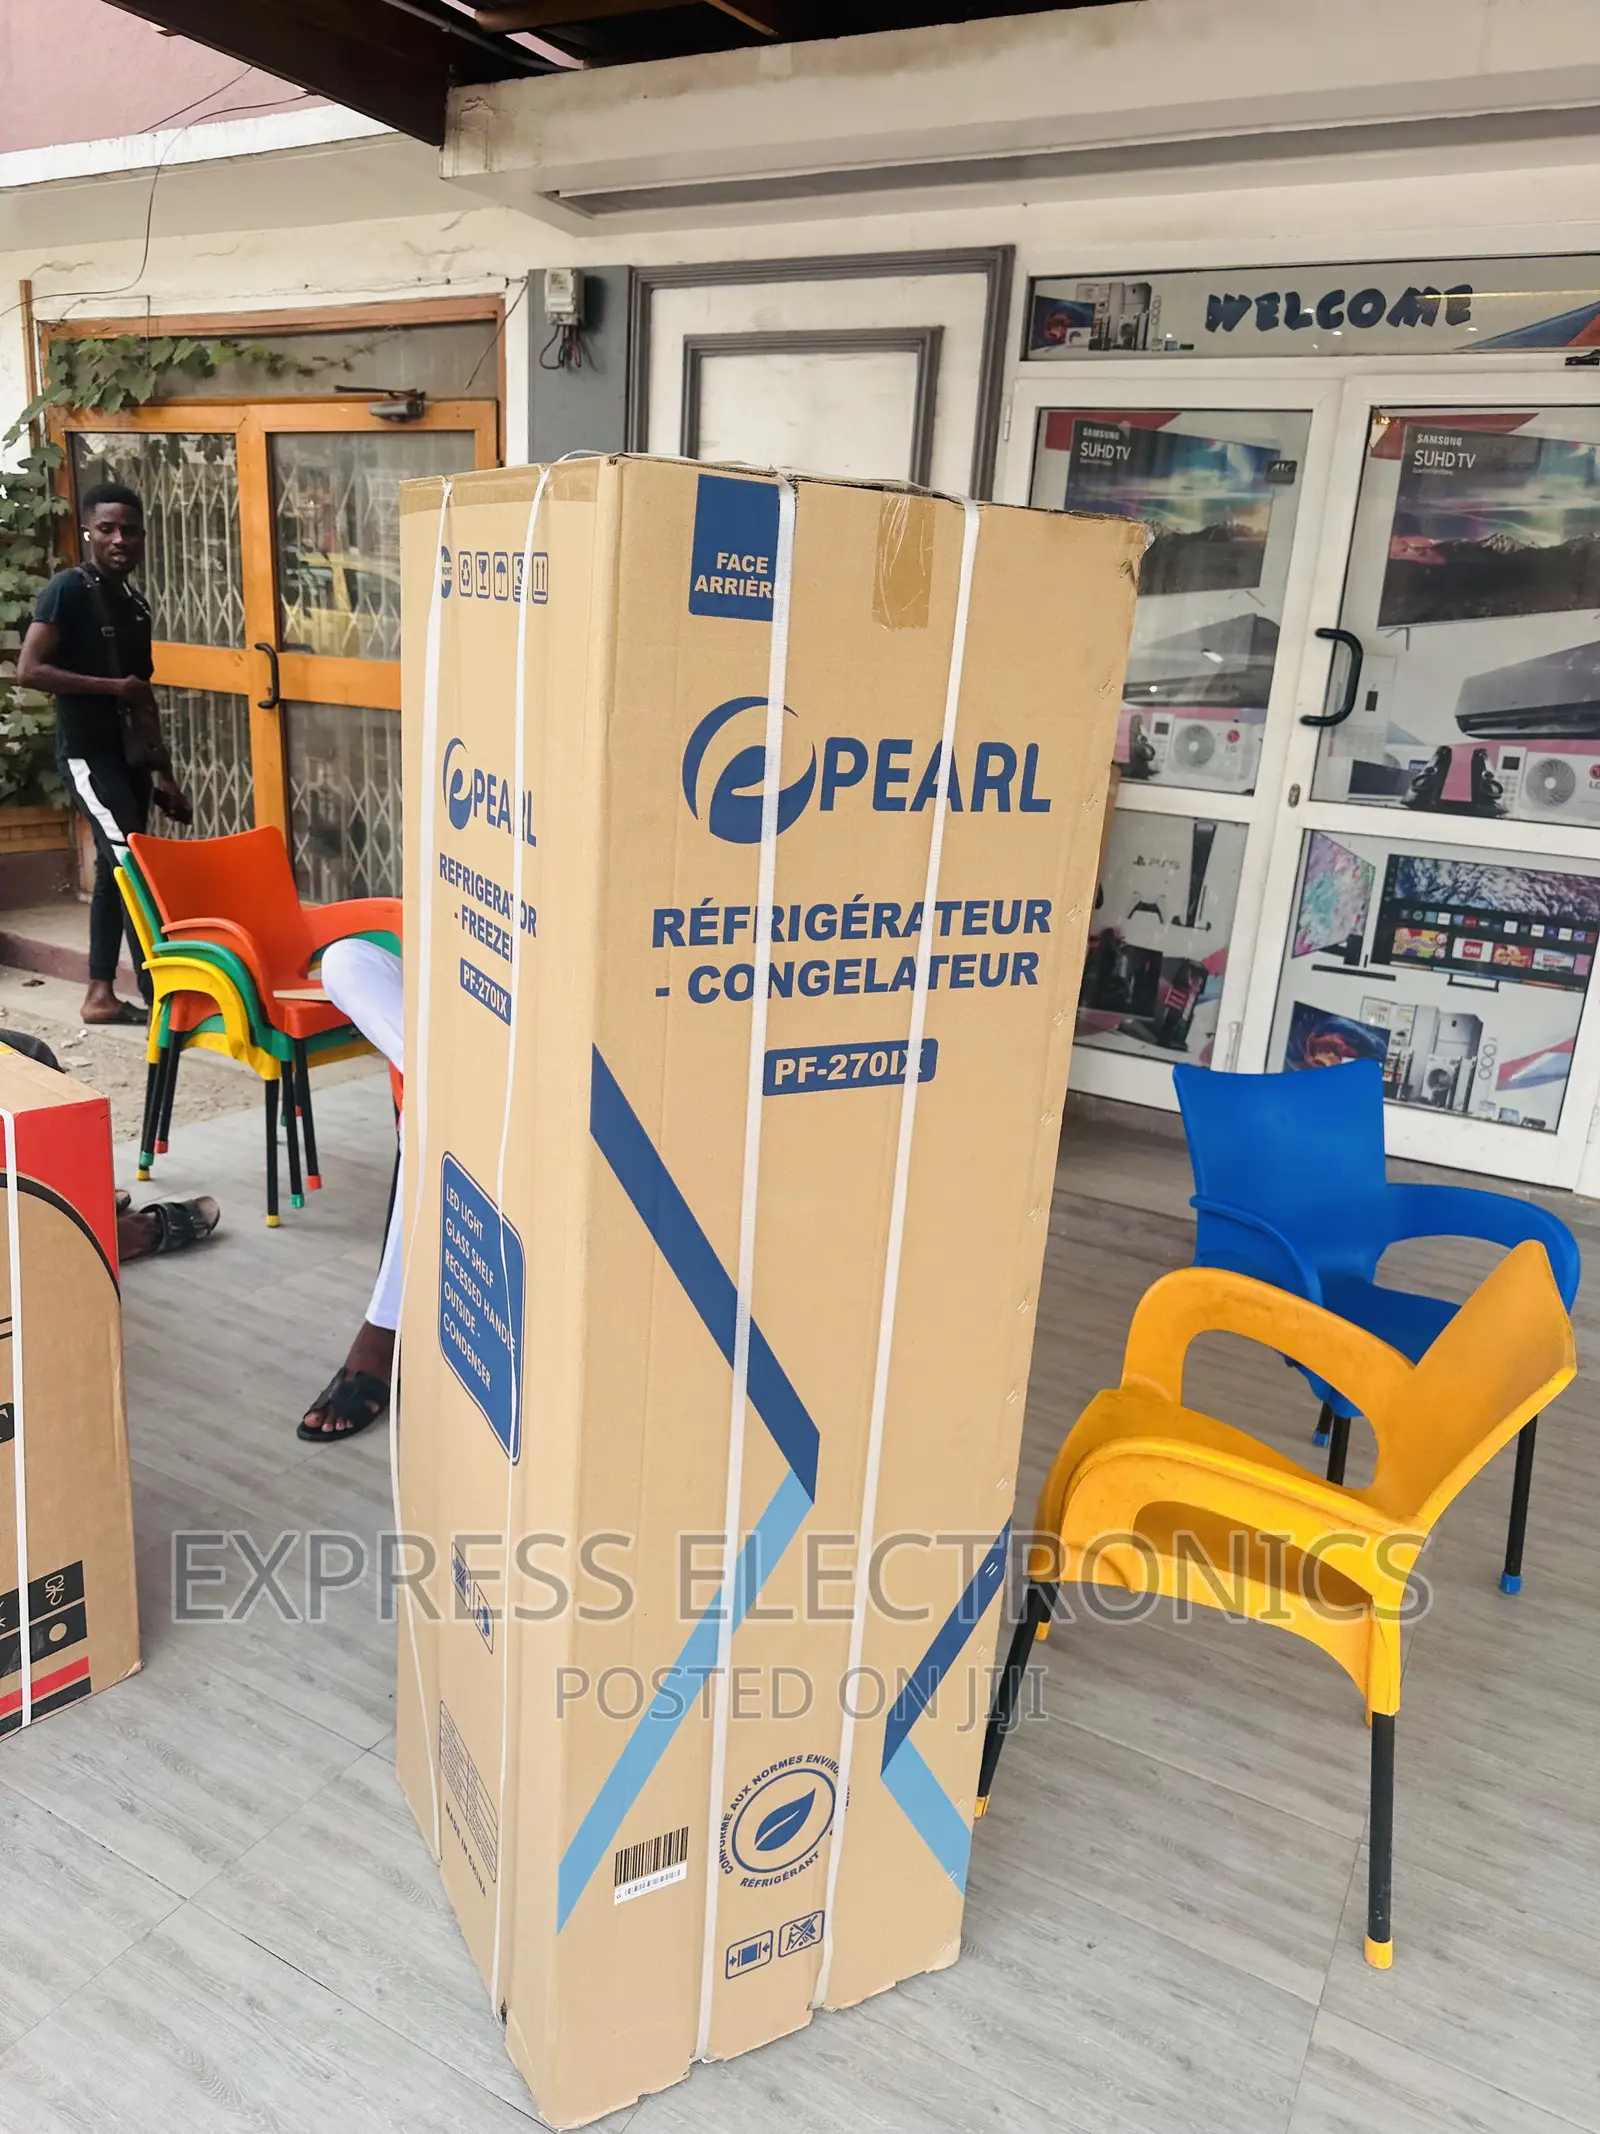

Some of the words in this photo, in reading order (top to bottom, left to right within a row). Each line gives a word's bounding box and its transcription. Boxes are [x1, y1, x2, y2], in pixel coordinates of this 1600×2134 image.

[1205, 284, 1474, 333] WELCOME
[1082, 427, 1120, 441] SAMSUNG
[1416, 434, 1463, 447] SAMSUNG
[693, 575, 775, 600] ARRIÈR
[716, 551, 770, 575] FACE
[819, 736, 1052, 814] PEARL
[461, 904, 513, 964] FREEZE
[651, 894, 1053, 949] RÉFRIGÉRATEUR
[463, 964, 508, 1019] PF-270IX
[687, 951, 1040, 1005] CONGELATEUR
[446, 1183, 460, 1212] LED
[461, 1200, 483, 1241] LIGHT
[445, 1217, 470, 1260] GLASS
[471, 1247, 494, 1289] SHELF
[445, 1248, 482, 1308] RECESSED
[444, 1281, 476, 1336] OUTSIDE
[443, 1312, 491, 1392] CONDENSER
[730, 1785, 752, 1812] AUX
[752, 1754, 804, 1786] NORMES
[740, 1850, 819, 1889] RÉFRIGÉRANT
